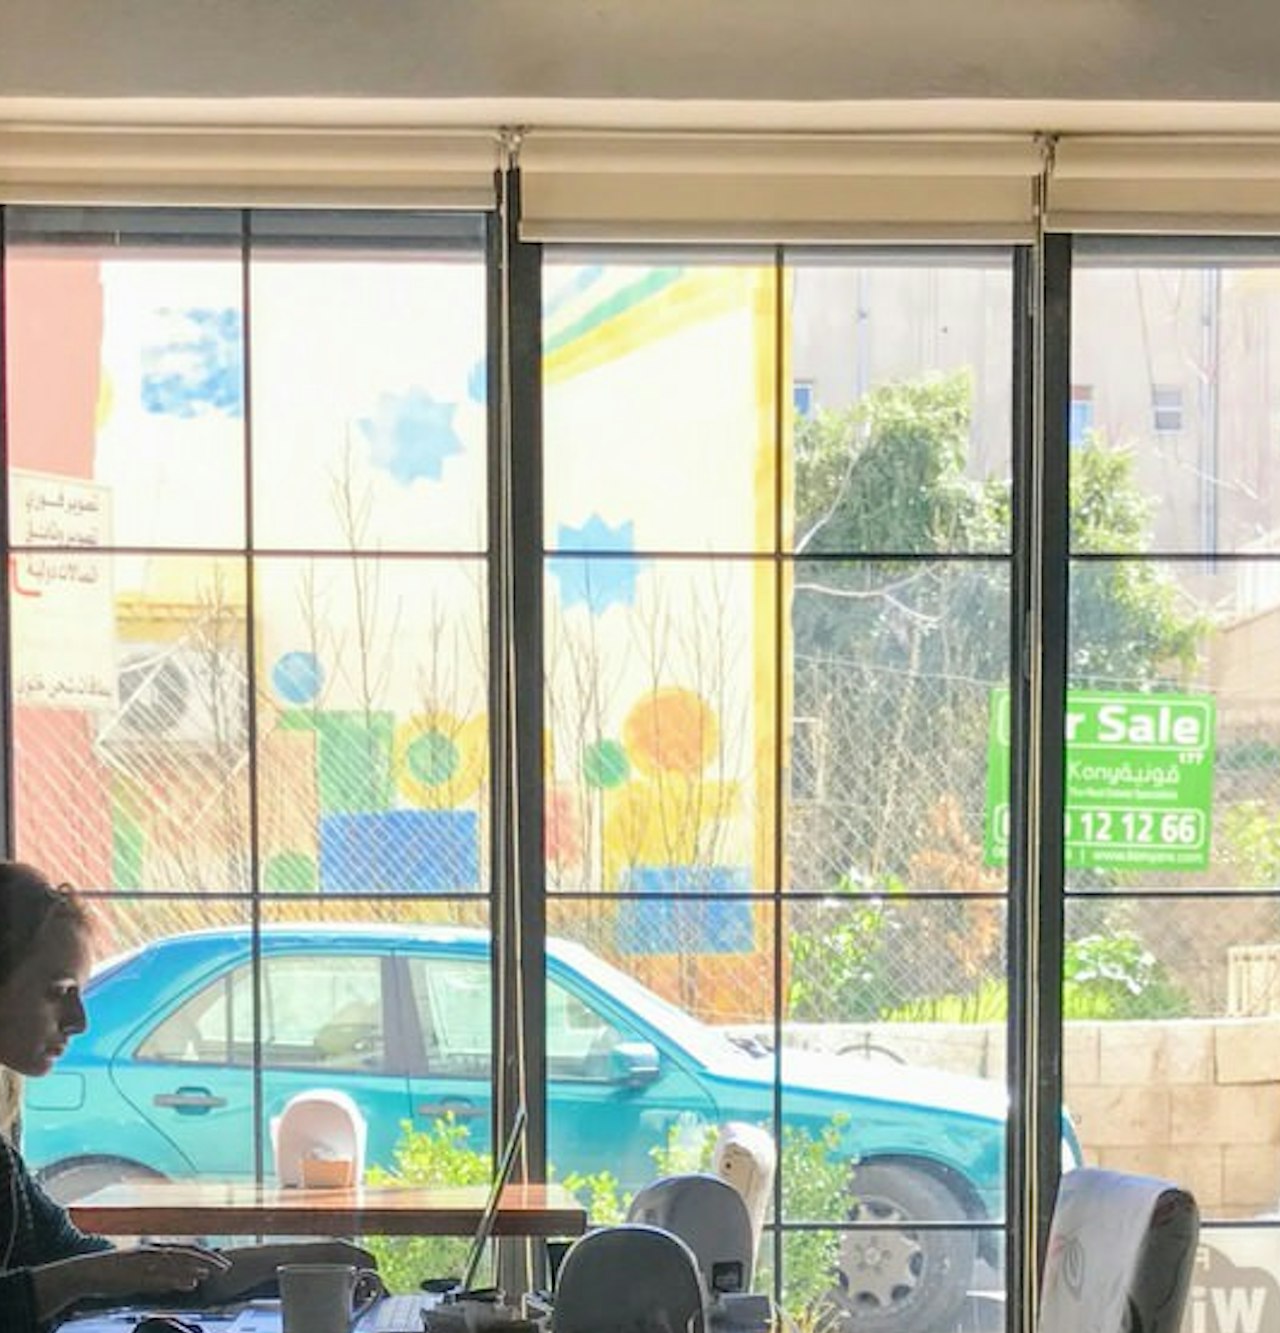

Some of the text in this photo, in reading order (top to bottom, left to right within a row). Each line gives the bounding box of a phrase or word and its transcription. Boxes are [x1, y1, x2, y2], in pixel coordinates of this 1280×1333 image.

[1097, 704, 1200, 745] Sale
[1081, 812, 1112, 840] 12
[1122, 813, 1153, 842] 12
[1162, 814, 1196, 843] 66
